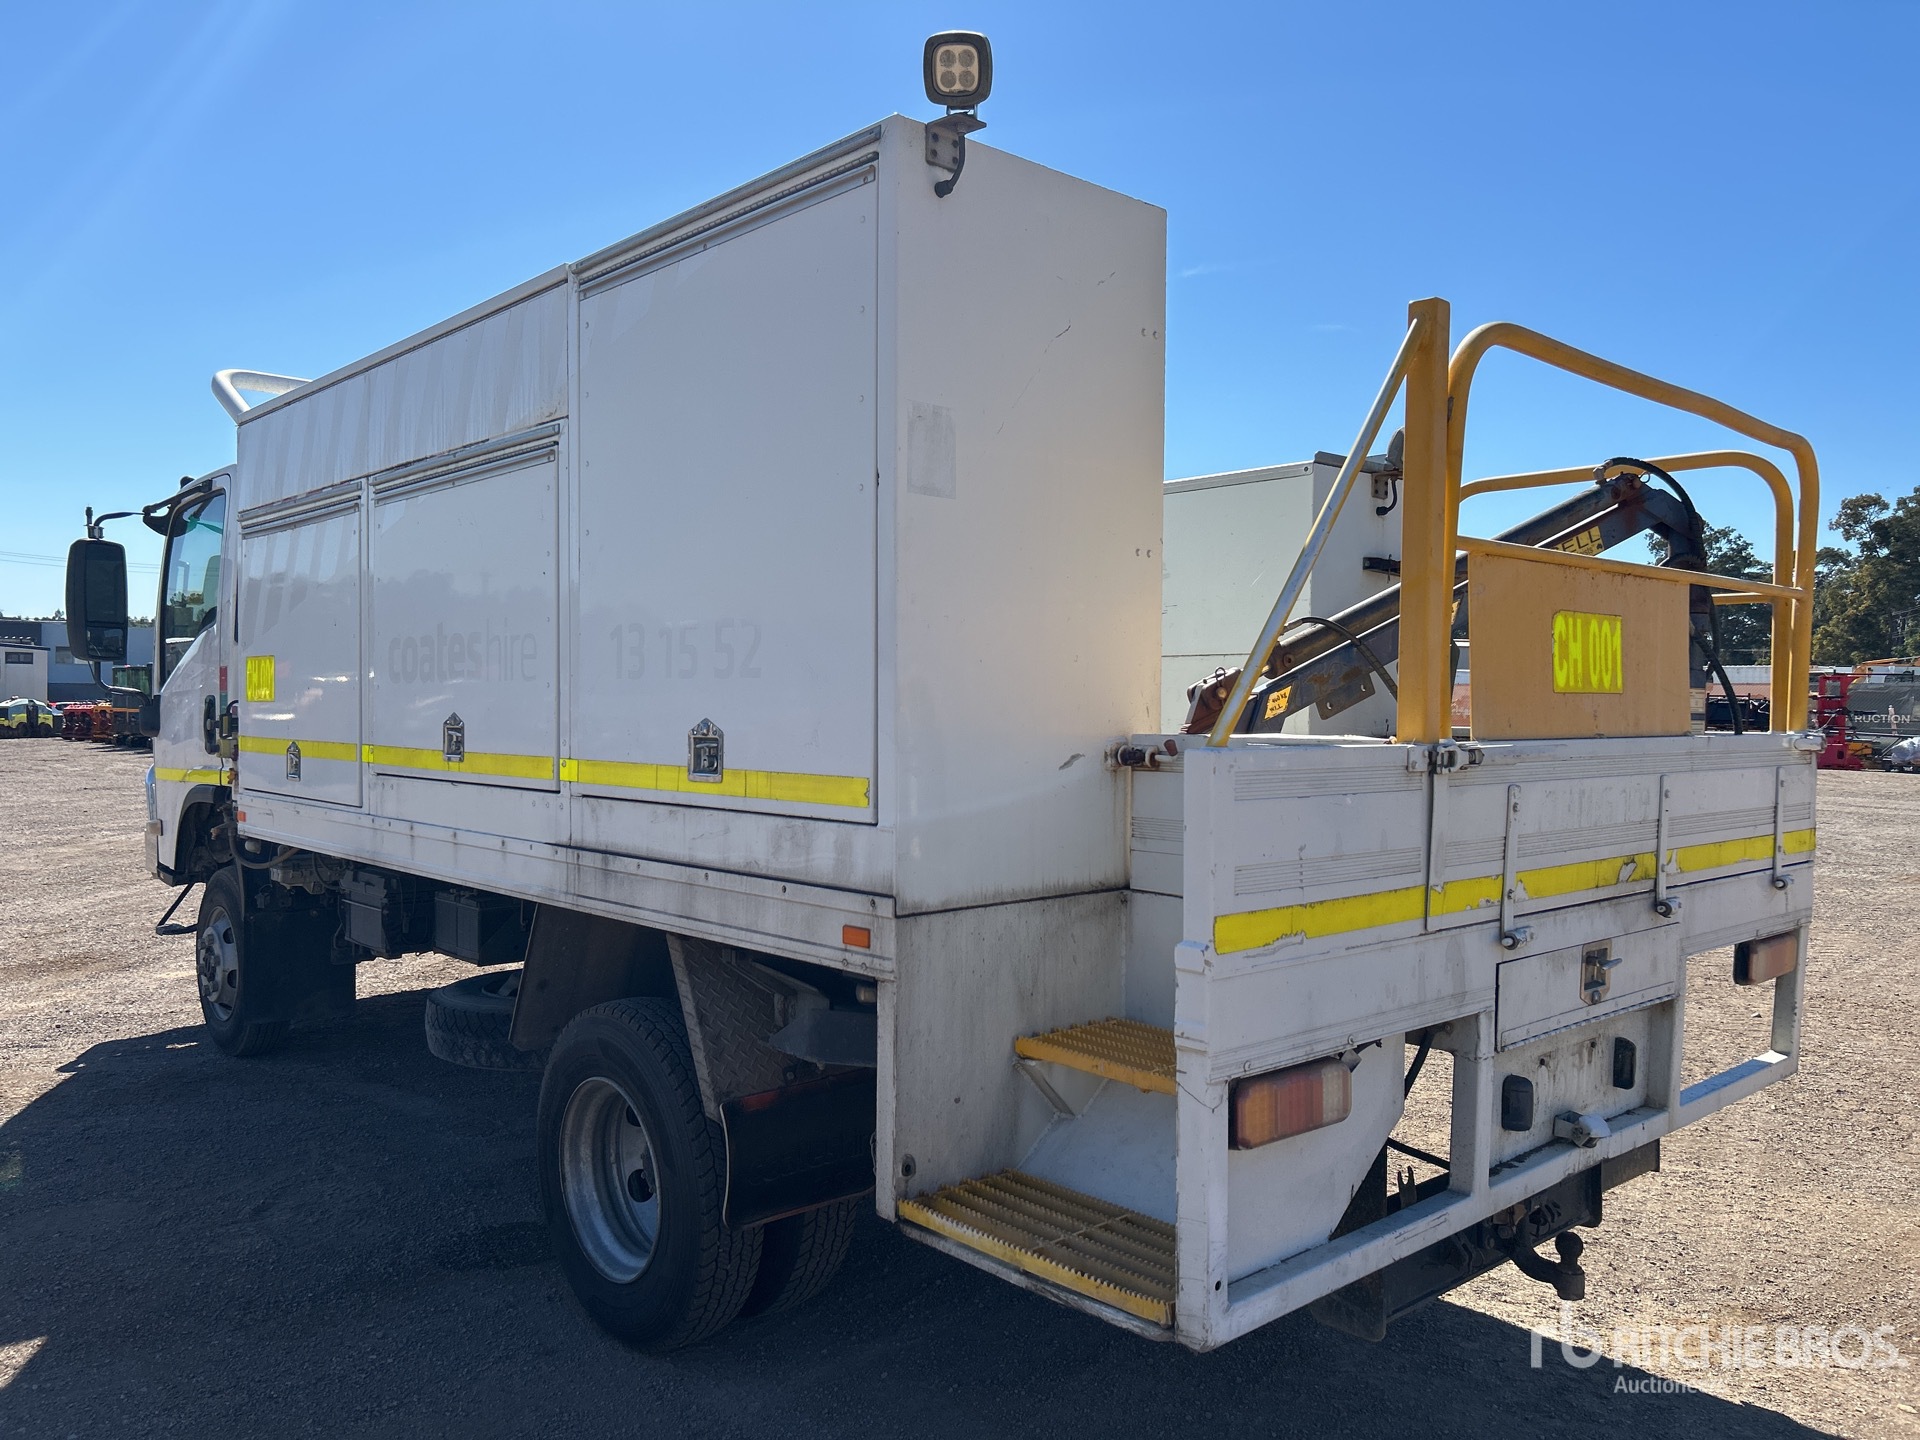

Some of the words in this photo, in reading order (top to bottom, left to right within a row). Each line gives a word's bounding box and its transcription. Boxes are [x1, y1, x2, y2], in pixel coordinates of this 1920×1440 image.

[609, 622, 646, 680] 13
[658, 625, 698, 679] 15
[713, 617, 762, 679] 52
[1554, 615, 1582, 687] CH
[1589, 619, 1622, 689] 001
[1850, 714, 1911, 723] RUCTION
